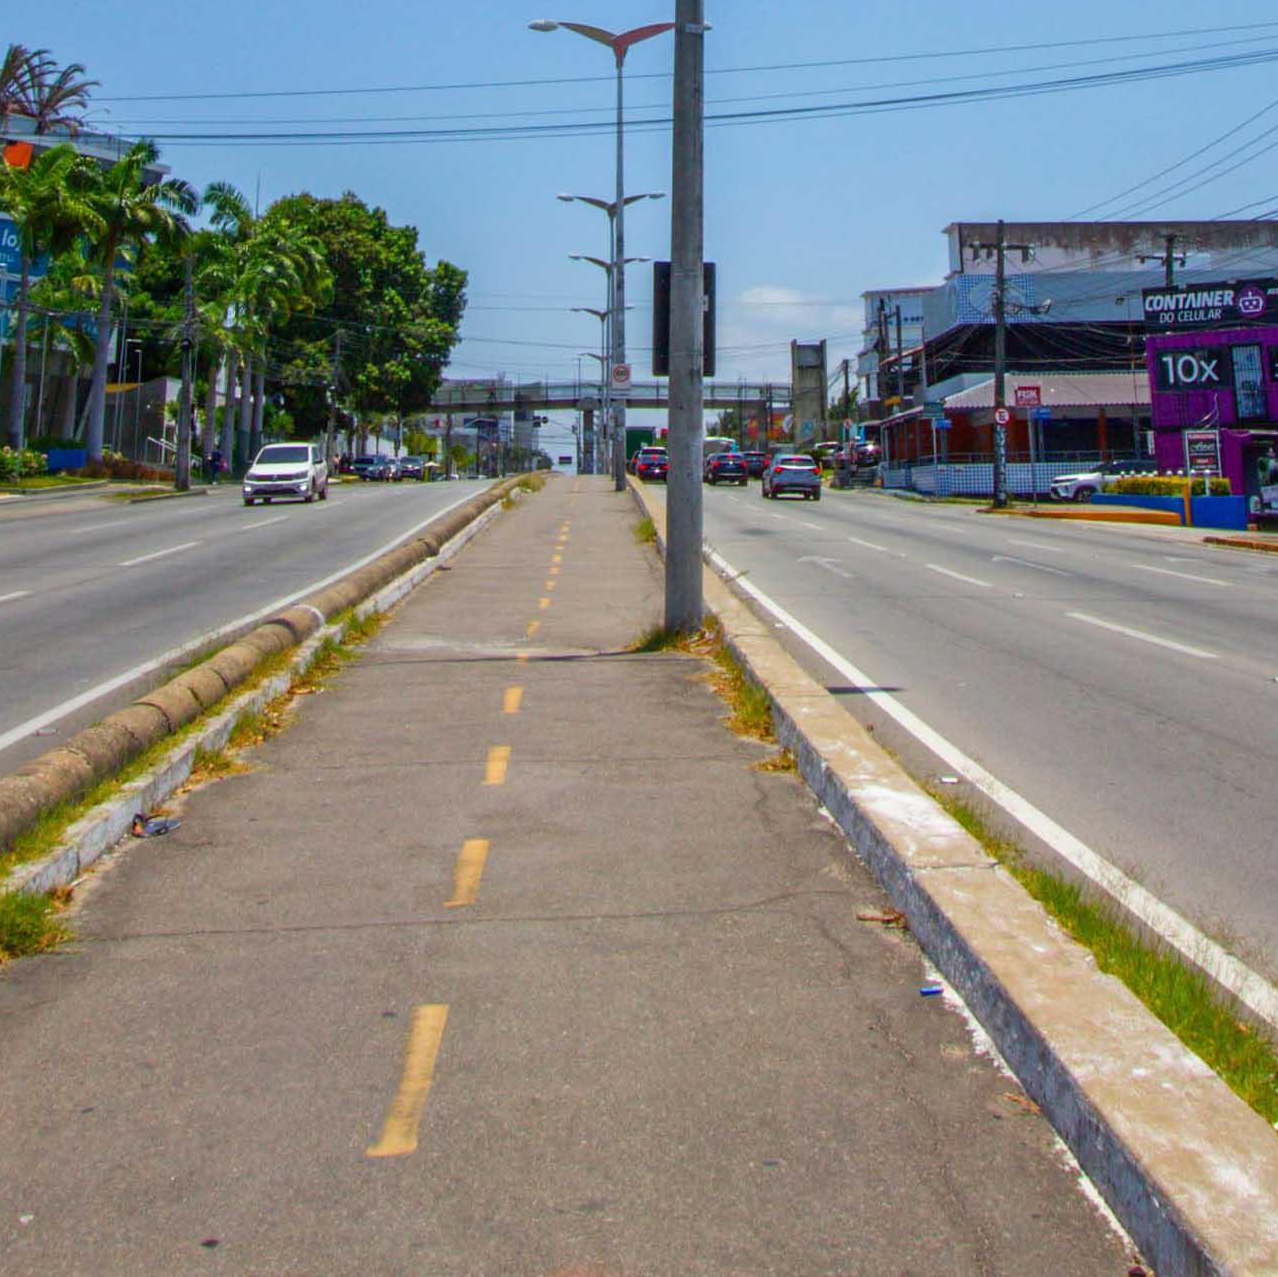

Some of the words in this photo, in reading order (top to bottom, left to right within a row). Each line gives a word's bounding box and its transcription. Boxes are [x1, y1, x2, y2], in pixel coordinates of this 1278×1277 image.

[1144, 289, 1236, 312] CONTAINER
[1159, 312, 1174, 323] DO
[1177, 308, 1222, 322] CELULAR
[1161, 353, 1220, 386] 10x
